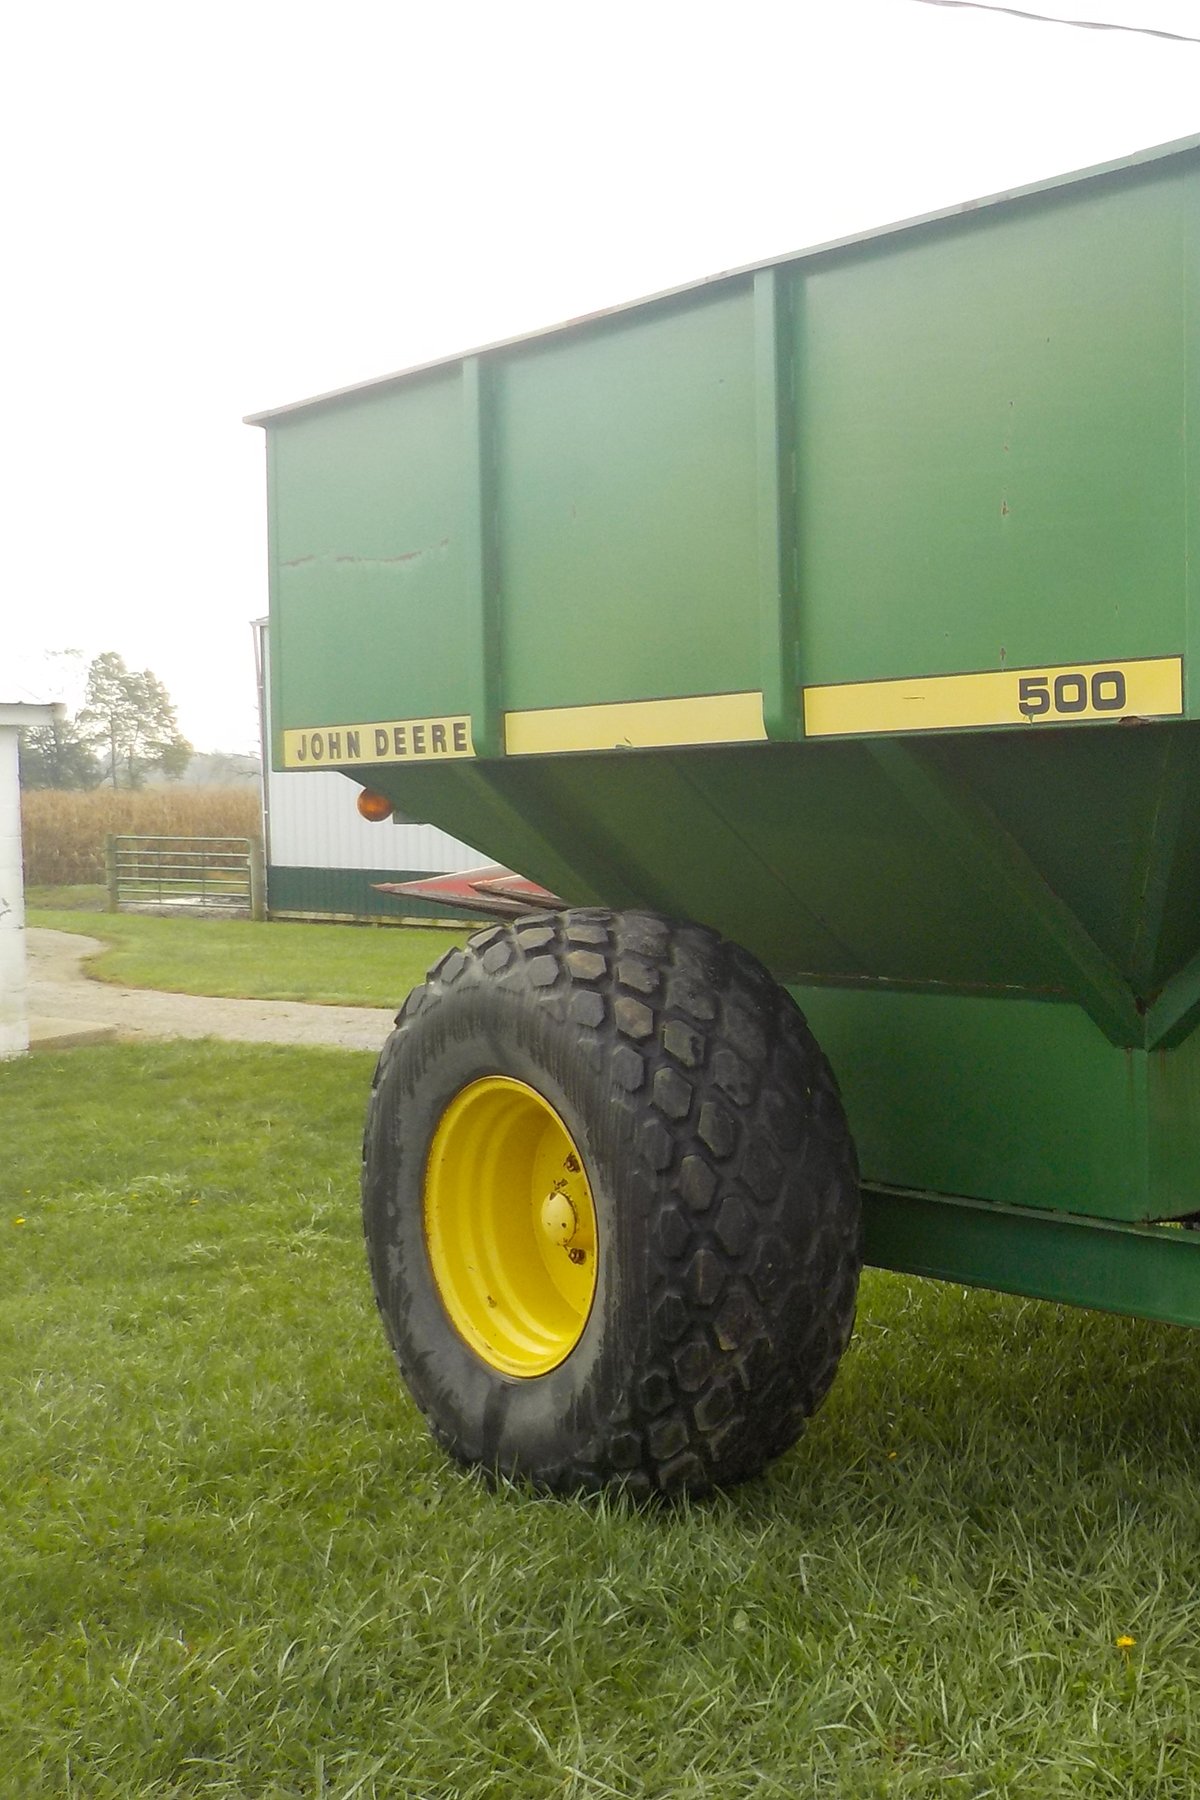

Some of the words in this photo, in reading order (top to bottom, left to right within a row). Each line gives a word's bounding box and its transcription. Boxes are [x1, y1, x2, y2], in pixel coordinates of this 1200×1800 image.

[1019, 670, 1126, 715] 500
[297, 731, 361, 761] JOHN
[375, 722, 467, 757] DEERE
